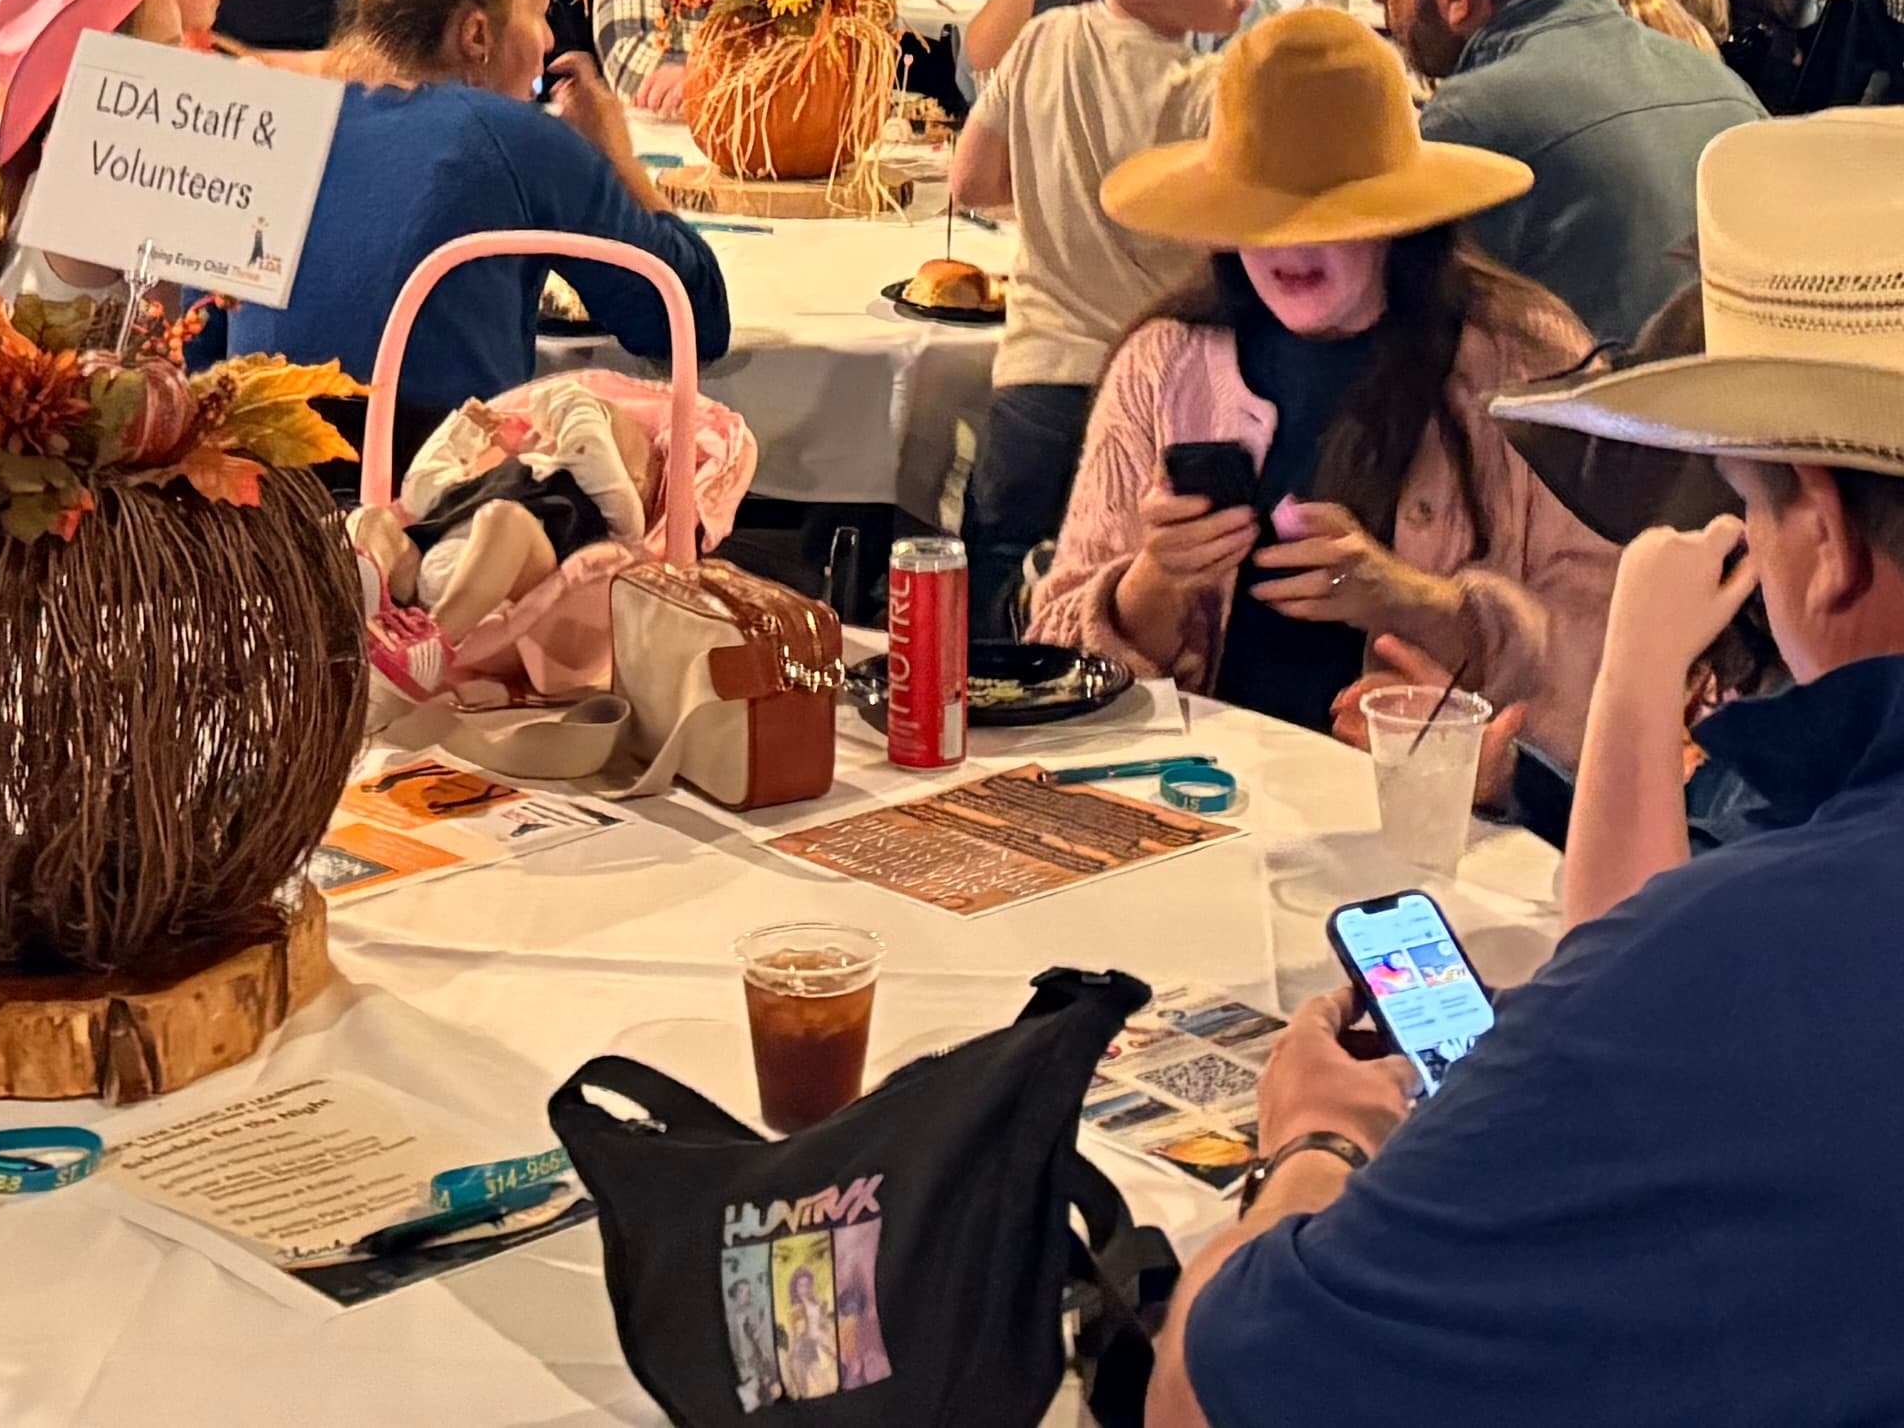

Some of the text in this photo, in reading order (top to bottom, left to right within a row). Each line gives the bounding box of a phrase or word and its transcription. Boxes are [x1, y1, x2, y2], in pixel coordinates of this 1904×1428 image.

[95, 76, 277, 150] LDA Staff &
[92, 140, 253, 210] Volunteers
[203, 259, 230, 276] Child
[277, 1097, 335, 1122] Night
